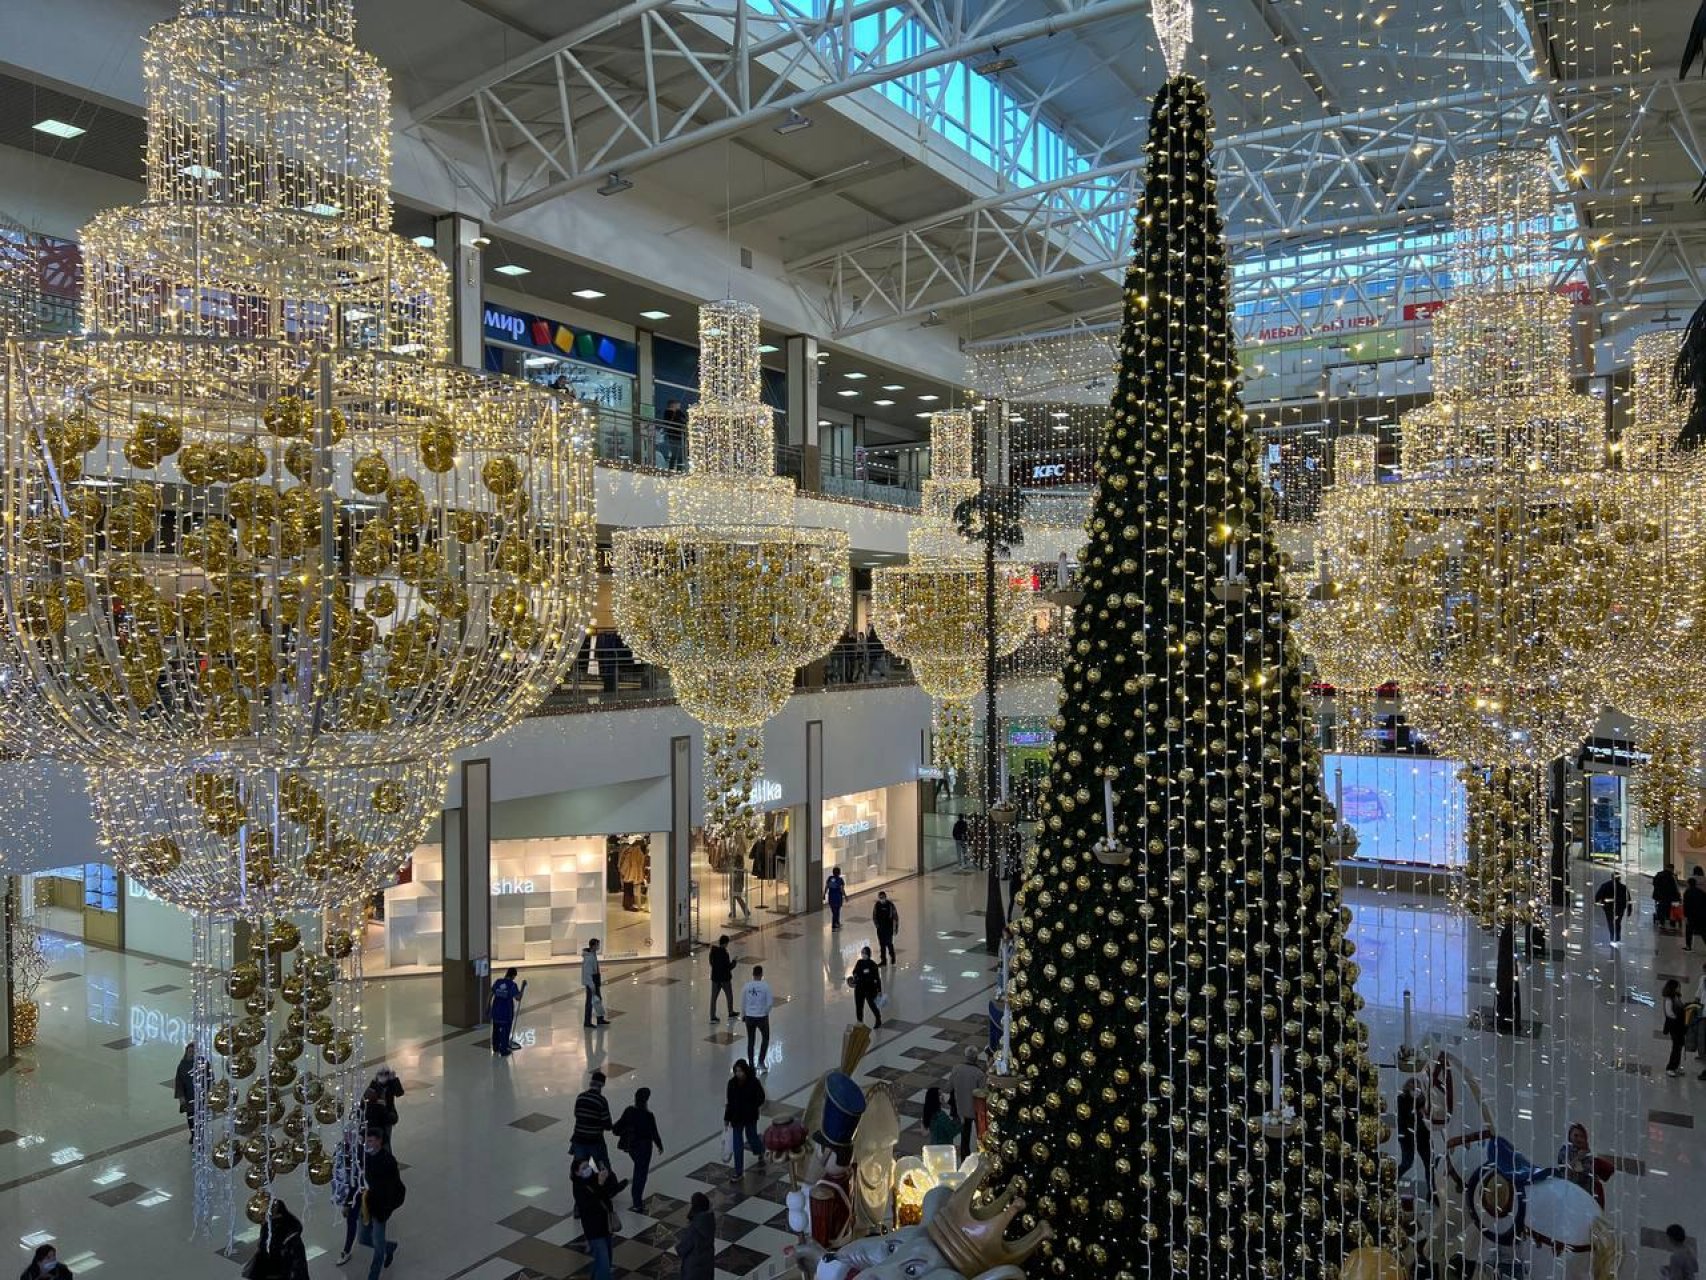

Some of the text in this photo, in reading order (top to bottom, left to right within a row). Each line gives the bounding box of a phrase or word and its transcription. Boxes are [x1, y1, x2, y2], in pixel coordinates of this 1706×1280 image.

[484, 309, 525, 341] мир
[1258, 316, 1345, 341] МЕБЕЛЫЙ
[1032, 463, 1066, 479] KFC
